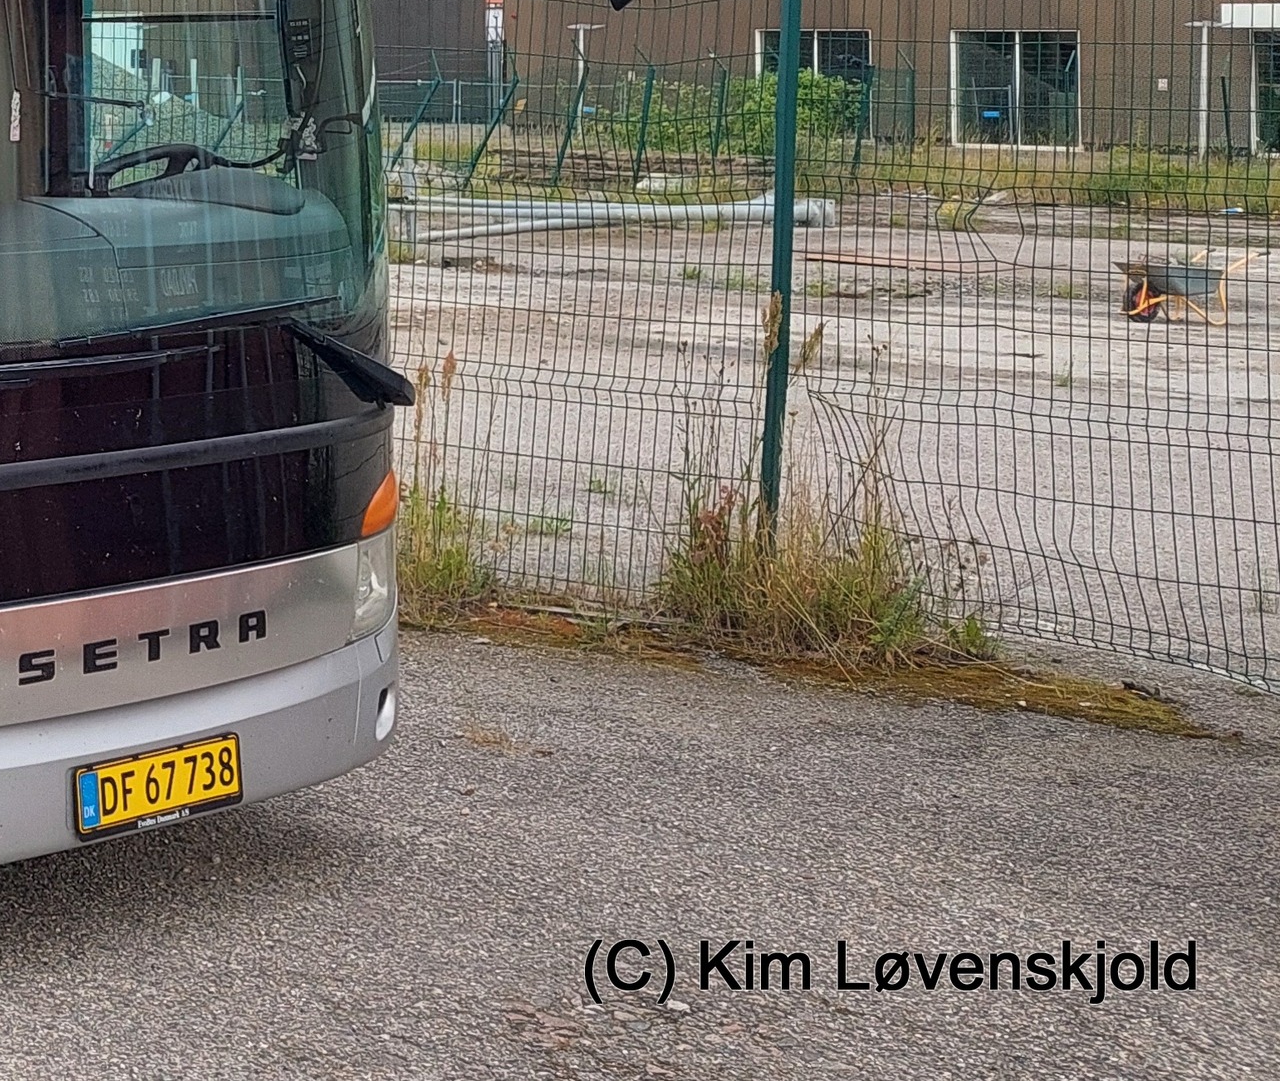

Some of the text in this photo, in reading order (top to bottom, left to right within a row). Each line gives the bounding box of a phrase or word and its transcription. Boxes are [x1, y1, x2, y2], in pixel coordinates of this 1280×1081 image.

[18, 609, 267, 686] SETRA
[83, 804, 96, 818] DK
[101, 746, 233, 816] DF 67 738
